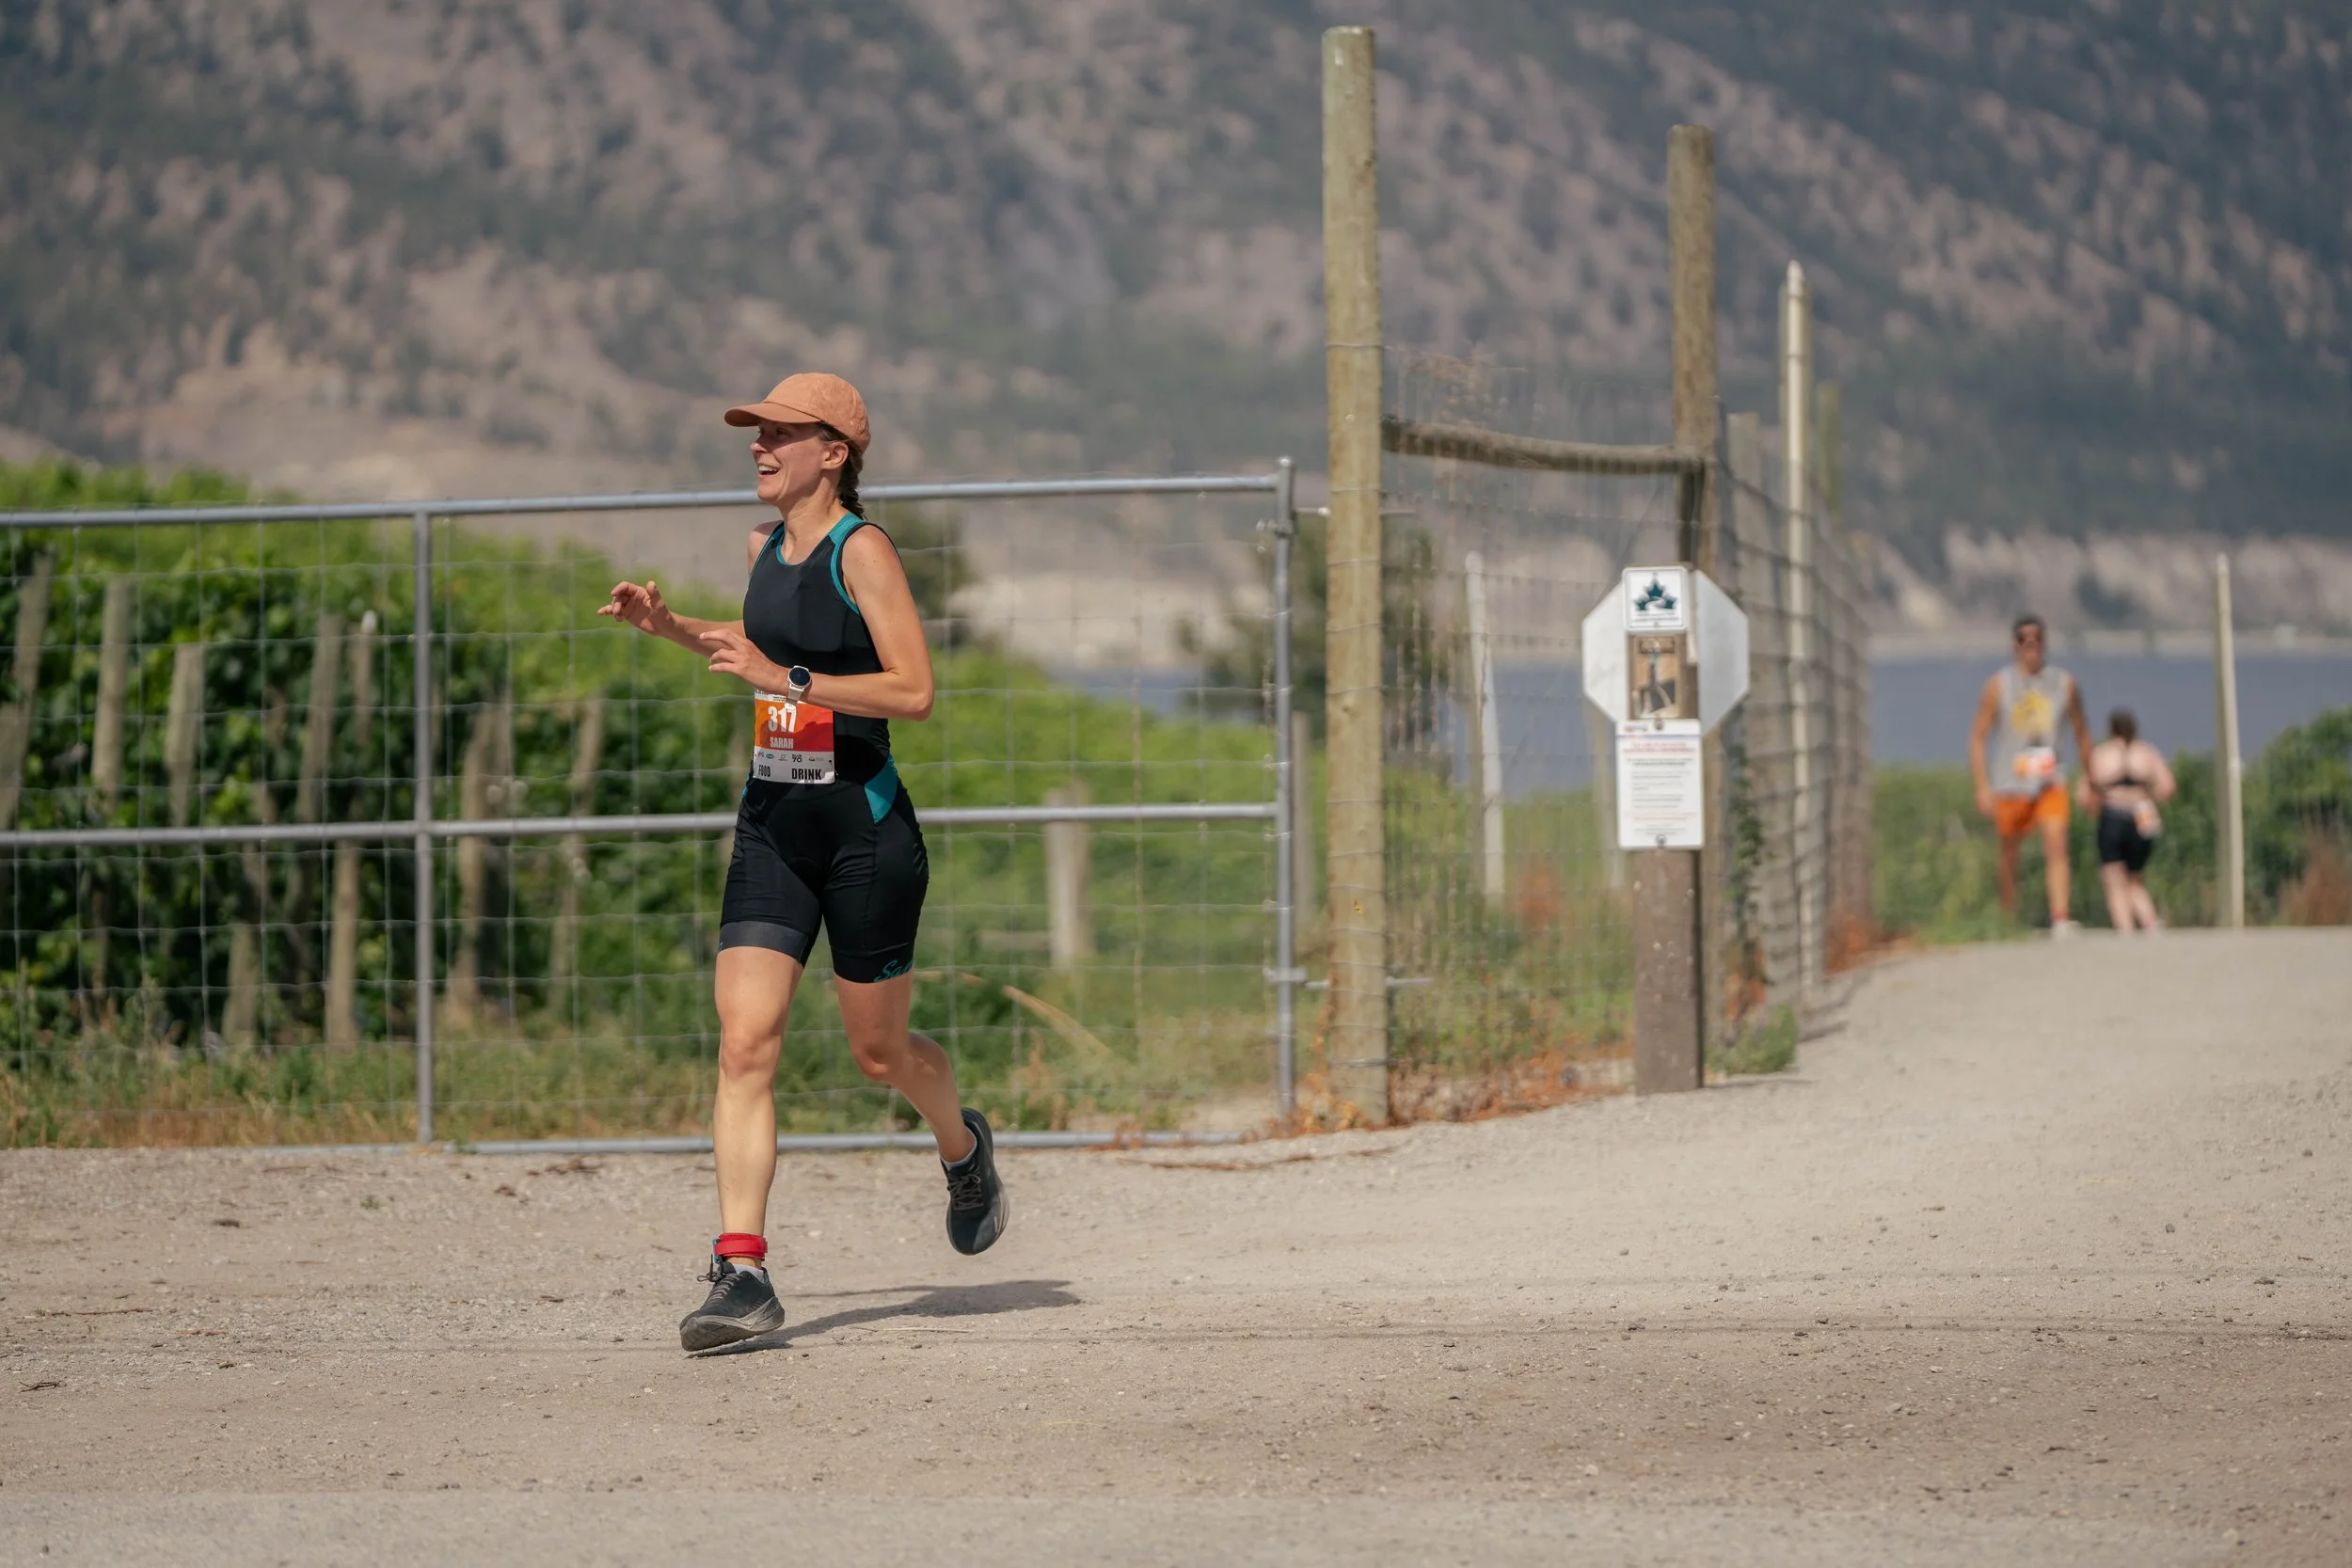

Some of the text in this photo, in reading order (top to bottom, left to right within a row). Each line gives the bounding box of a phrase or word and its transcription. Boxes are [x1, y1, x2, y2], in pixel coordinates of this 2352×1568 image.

[768, 705, 797, 733] 317
[770, 736, 794, 750] SARAH
[758, 764, 771, 777] FOOD
[791, 768, 821, 780] DRINK
